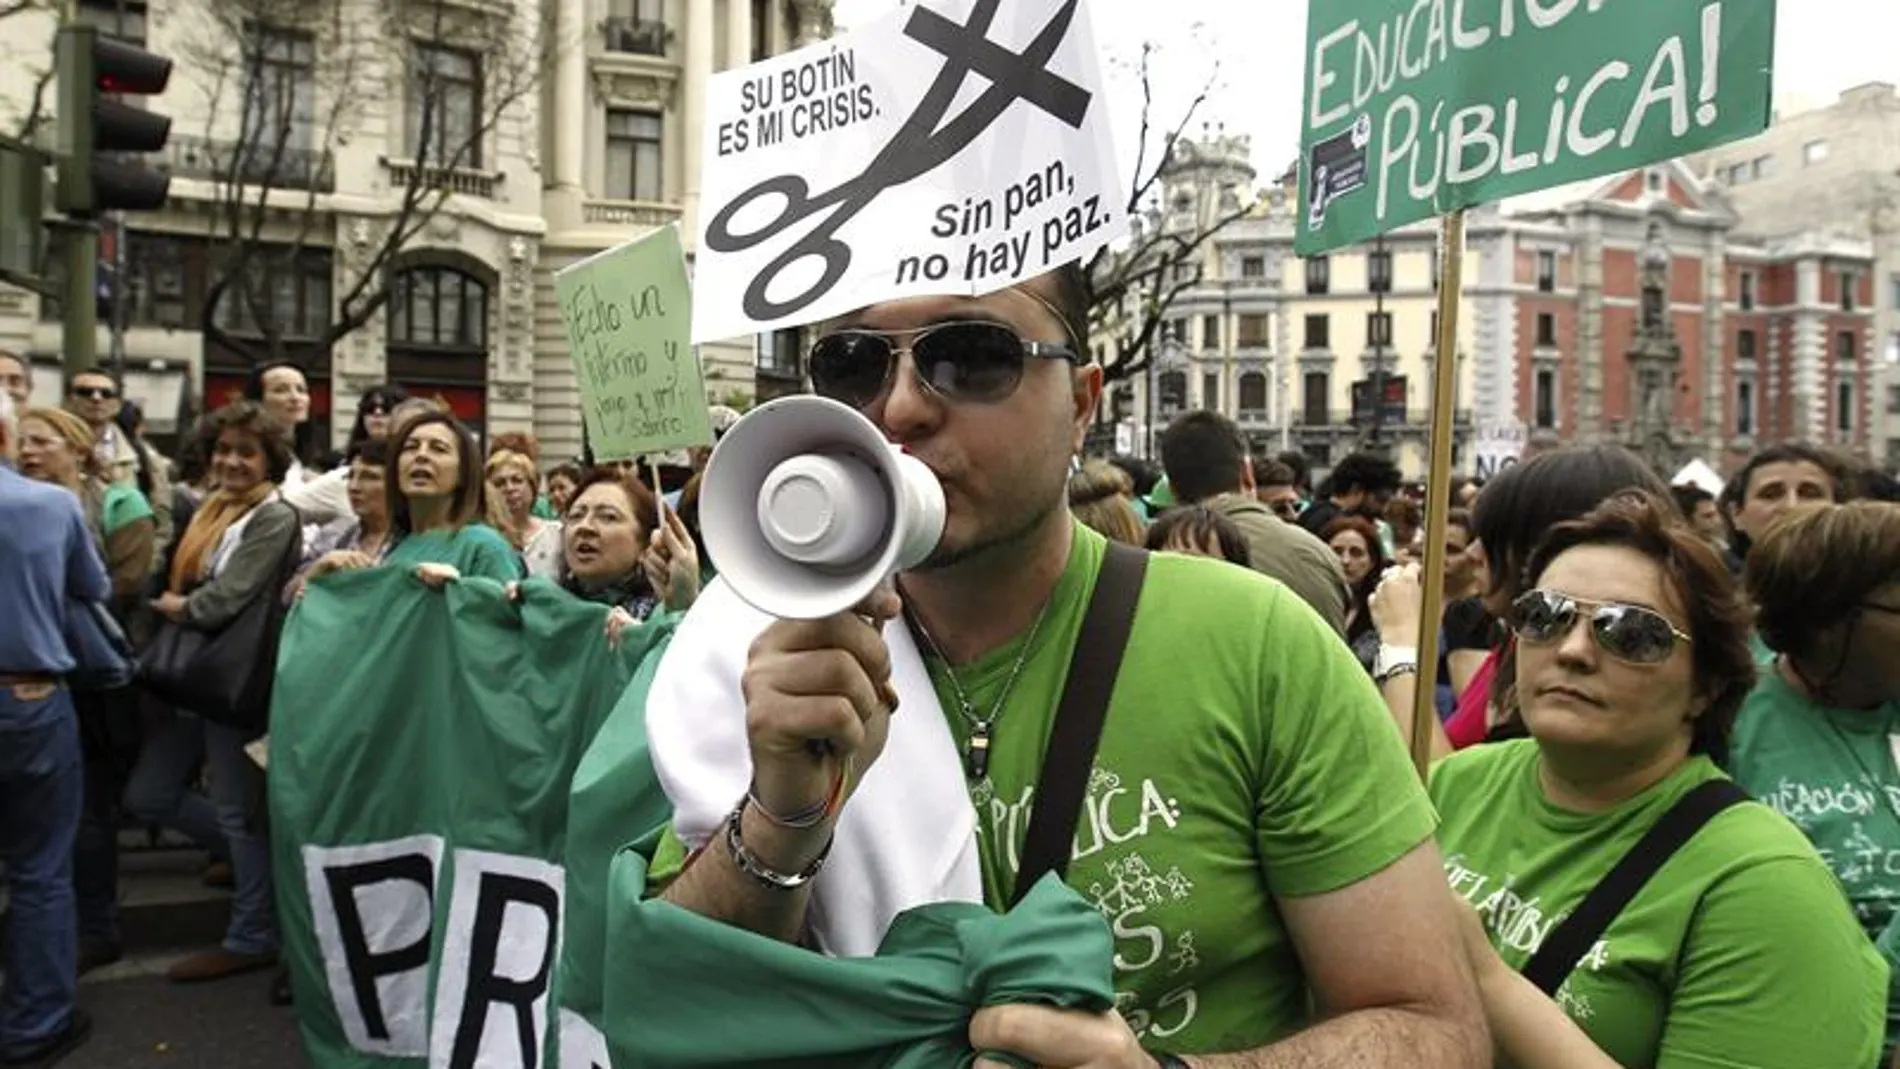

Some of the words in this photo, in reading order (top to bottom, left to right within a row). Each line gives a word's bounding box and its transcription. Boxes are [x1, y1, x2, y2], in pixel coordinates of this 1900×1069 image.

[740, 77, 772, 113] SU
[781, 46, 855, 102] BOTÍN
[718, 119, 749, 156] ES
[757, 110, 783, 148] MI
[790, 85, 880, 138] CRISIS.
[931, 198, 992, 238] Sin
[1004, 160, 1074, 222] pan,
[895, 253, 949, 284] no
[964, 230, 1031, 280] hay
[1042, 195, 1110, 263] paz.
[631, 285, 665, 320] un
